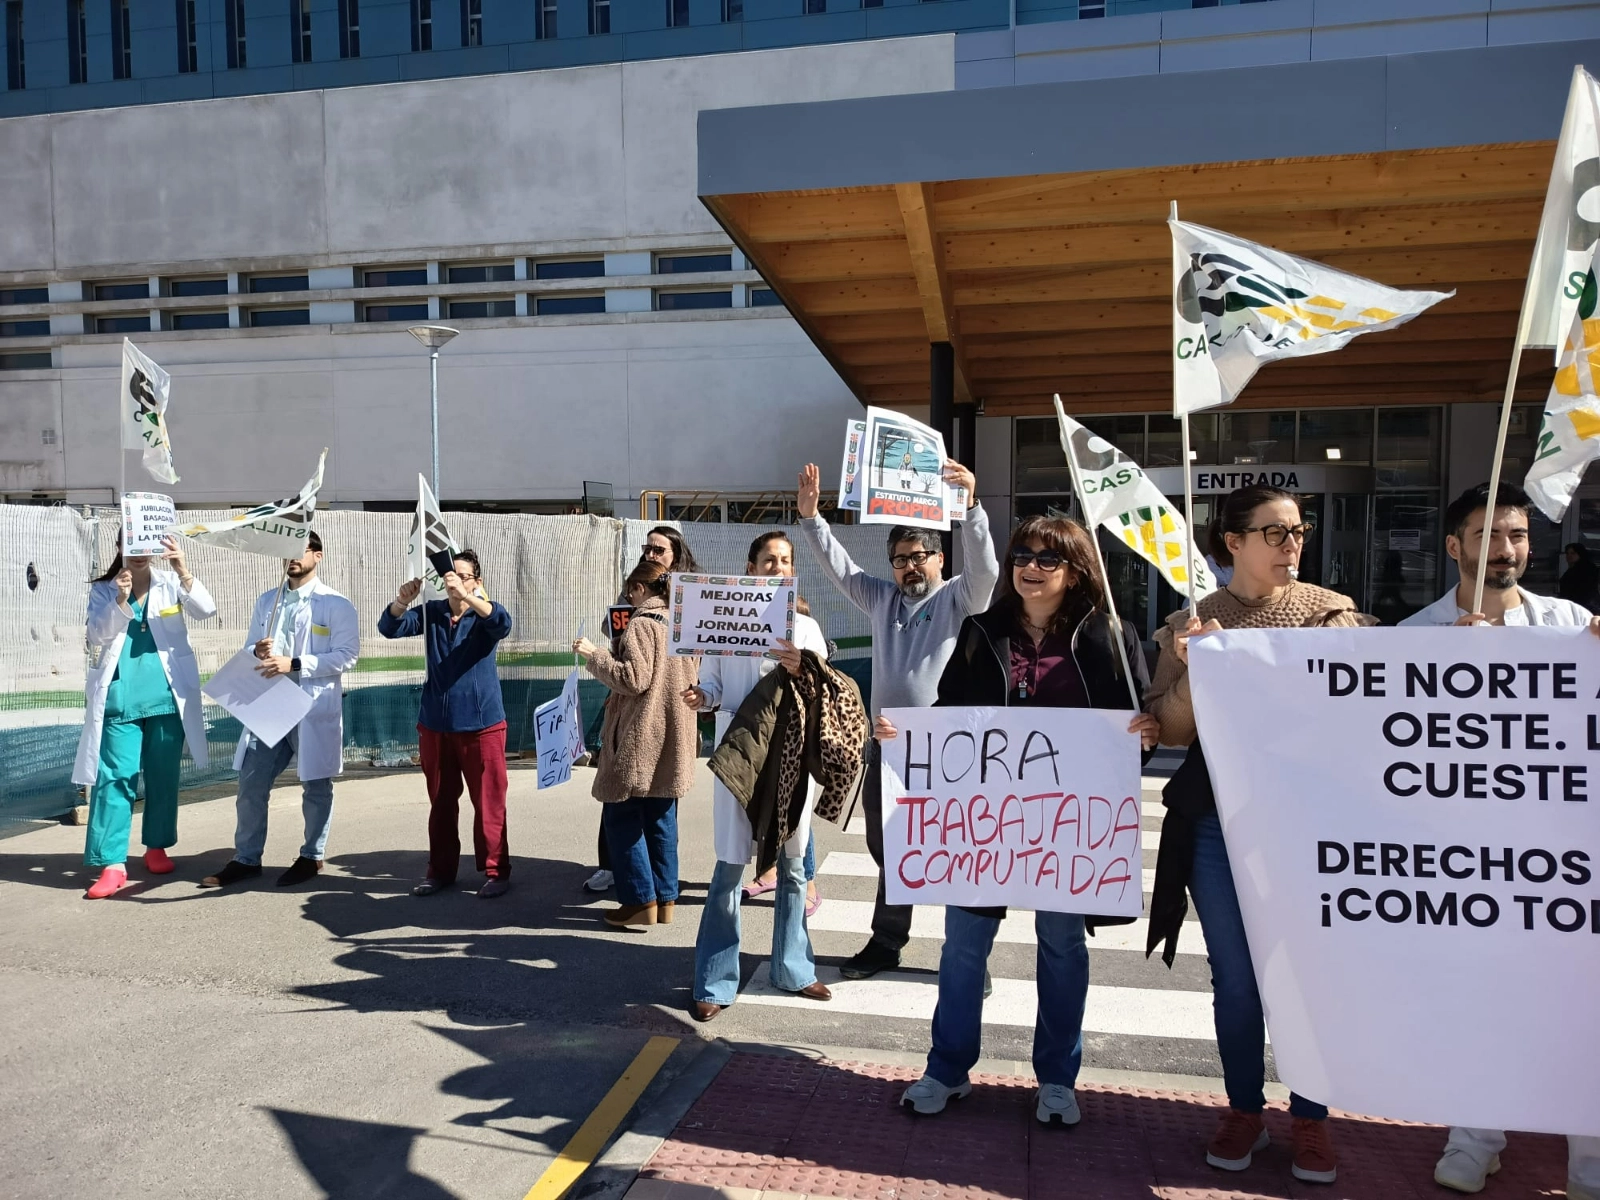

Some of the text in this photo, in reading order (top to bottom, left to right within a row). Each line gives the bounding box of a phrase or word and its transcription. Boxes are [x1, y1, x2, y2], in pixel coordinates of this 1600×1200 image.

[875, 491, 938, 507] ESTATUTO MARCO
[1197, 472, 1299, 489] ENTRADA
[869, 498, 943, 520] PROPIO
[700, 589, 773, 603] MEJORAS
[713, 606, 758, 617] EN LA
[695, 620, 773, 633] JORNADA
[697, 634, 770, 647] LABORAL
[1405, 662, 1577, 699] NORTE
[1382, 711, 1566, 750] OESTE.
[904, 728, 1060, 791] HORA
[1383, 761, 1588, 802] CUESTE
[896, 792, 1140, 857] TRABAJADA
[898, 847, 1132, 902] COMPUTADA
[1317, 840, 1592, 885] DERECHOS
[1320, 887, 1500, 928] ¡COMO
